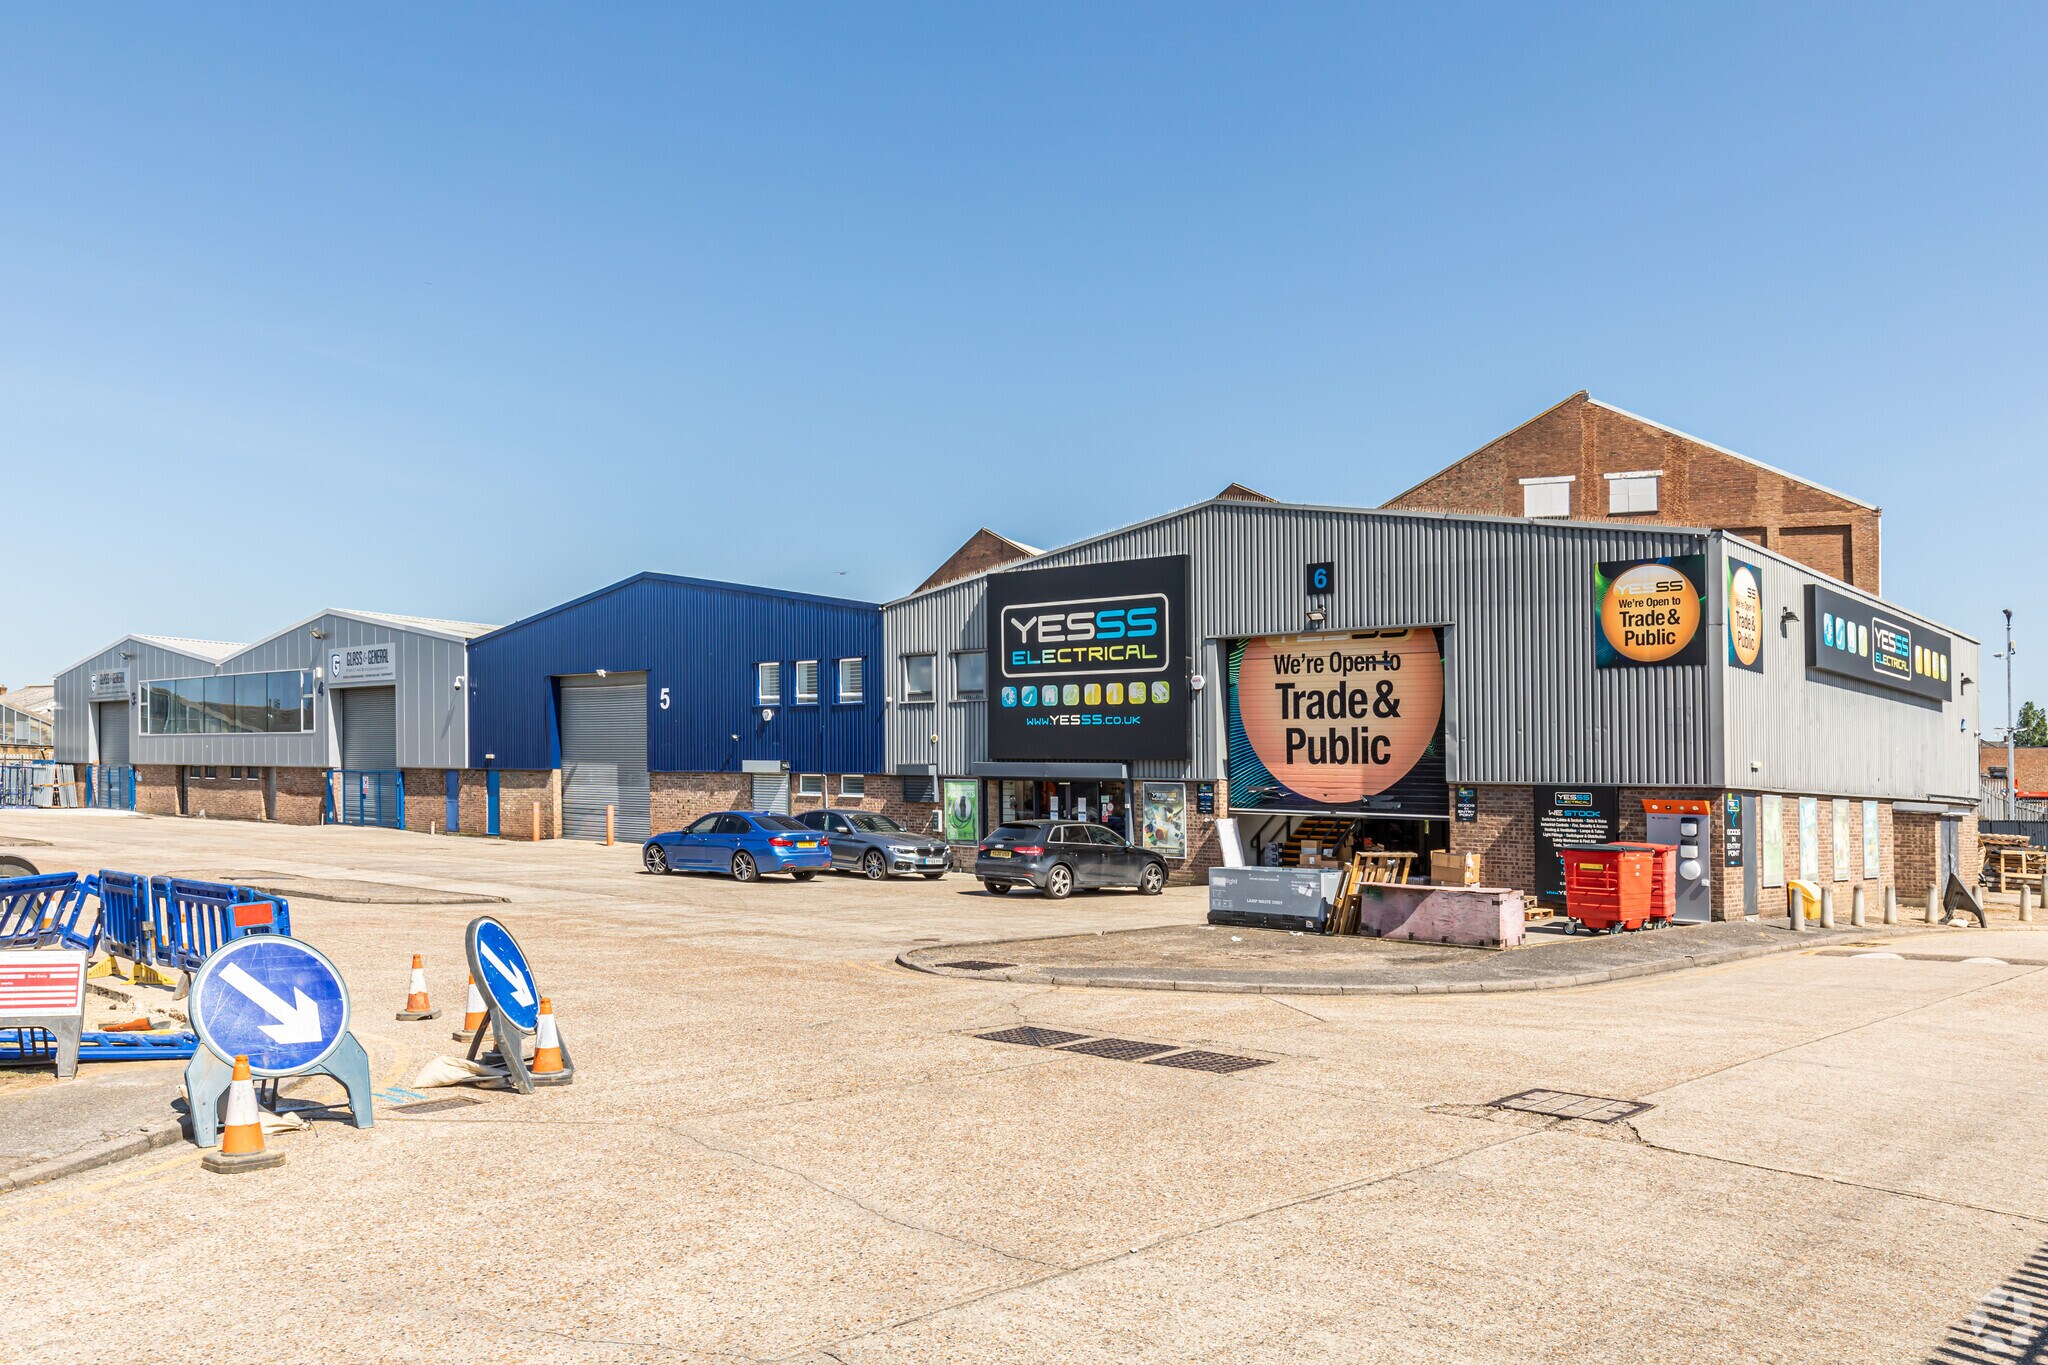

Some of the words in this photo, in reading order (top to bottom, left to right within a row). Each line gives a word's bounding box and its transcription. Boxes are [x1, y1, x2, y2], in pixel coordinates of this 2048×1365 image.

[1314, 568, 1327, 589] 6
[1616, 580, 1683, 595] YESSS
[1618, 599, 1644, 608] We're
[1646, 597, 1669, 608] Open
[1672, 596, 1681, 605] to
[1011, 607, 1157, 644] YESSS
[1619, 609, 1665, 627] Trade
[1667, 608, 1680, 625] &
[1736, 611, 1751, 630] Trade
[1625, 629, 1676, 646] Public
[1737, 630, 1755, 650] Public
[1874, 627, 1909, 657] YESSS
[346, 651, 363, 667] GLASS
[368, 649, 389, 665] GENERAL
[1012, 644, 1158, 666] ELECTRICAL
[1274, 653, 1324, 674] We're
[1329, 651, 1377, 677] Open
[1382, 650, 1401, 671] to
[1875, 652, 1909, 672] ELECTRICAL
[318, 681, 324, 697] 4
[660, 687, 670, 710] 5
[1275, 680, 1368, 720] Trade
[1372, 679, 1401, 719] &
[1286, 726, 1391, 765] Public
